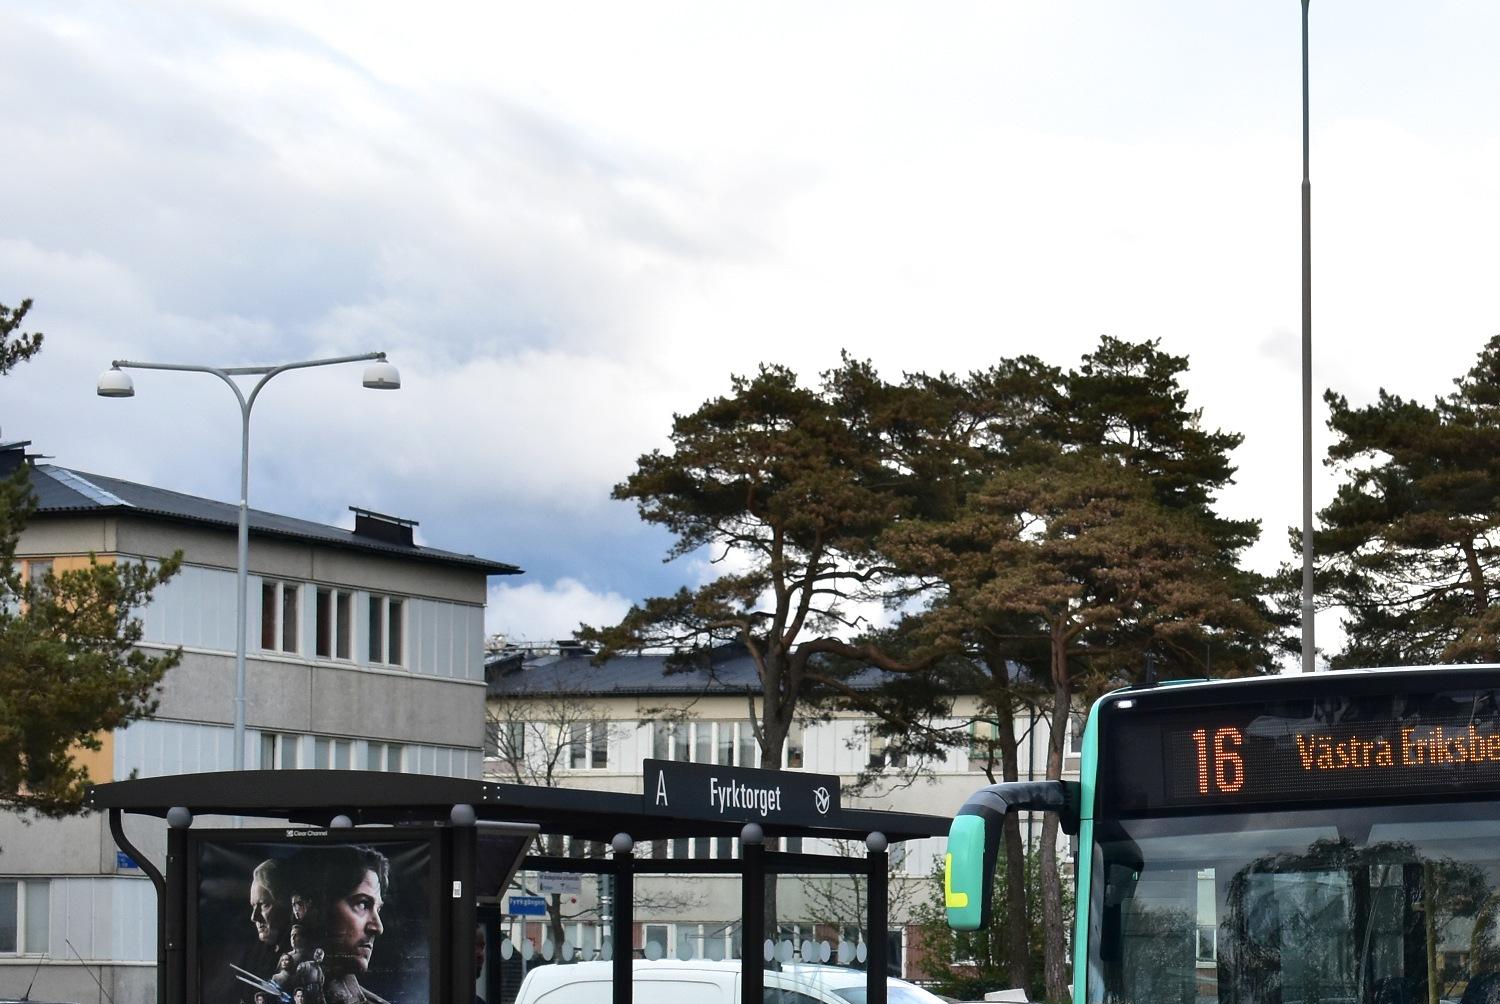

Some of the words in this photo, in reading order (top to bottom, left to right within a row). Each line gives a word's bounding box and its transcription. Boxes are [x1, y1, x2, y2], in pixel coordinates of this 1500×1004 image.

[1192, 727, 1244, 793] 16
[1297, 733, 1394, 770] Västra
[655, 770, 668, 806] A
[710, 777, 781, 816] Fyrktorget
